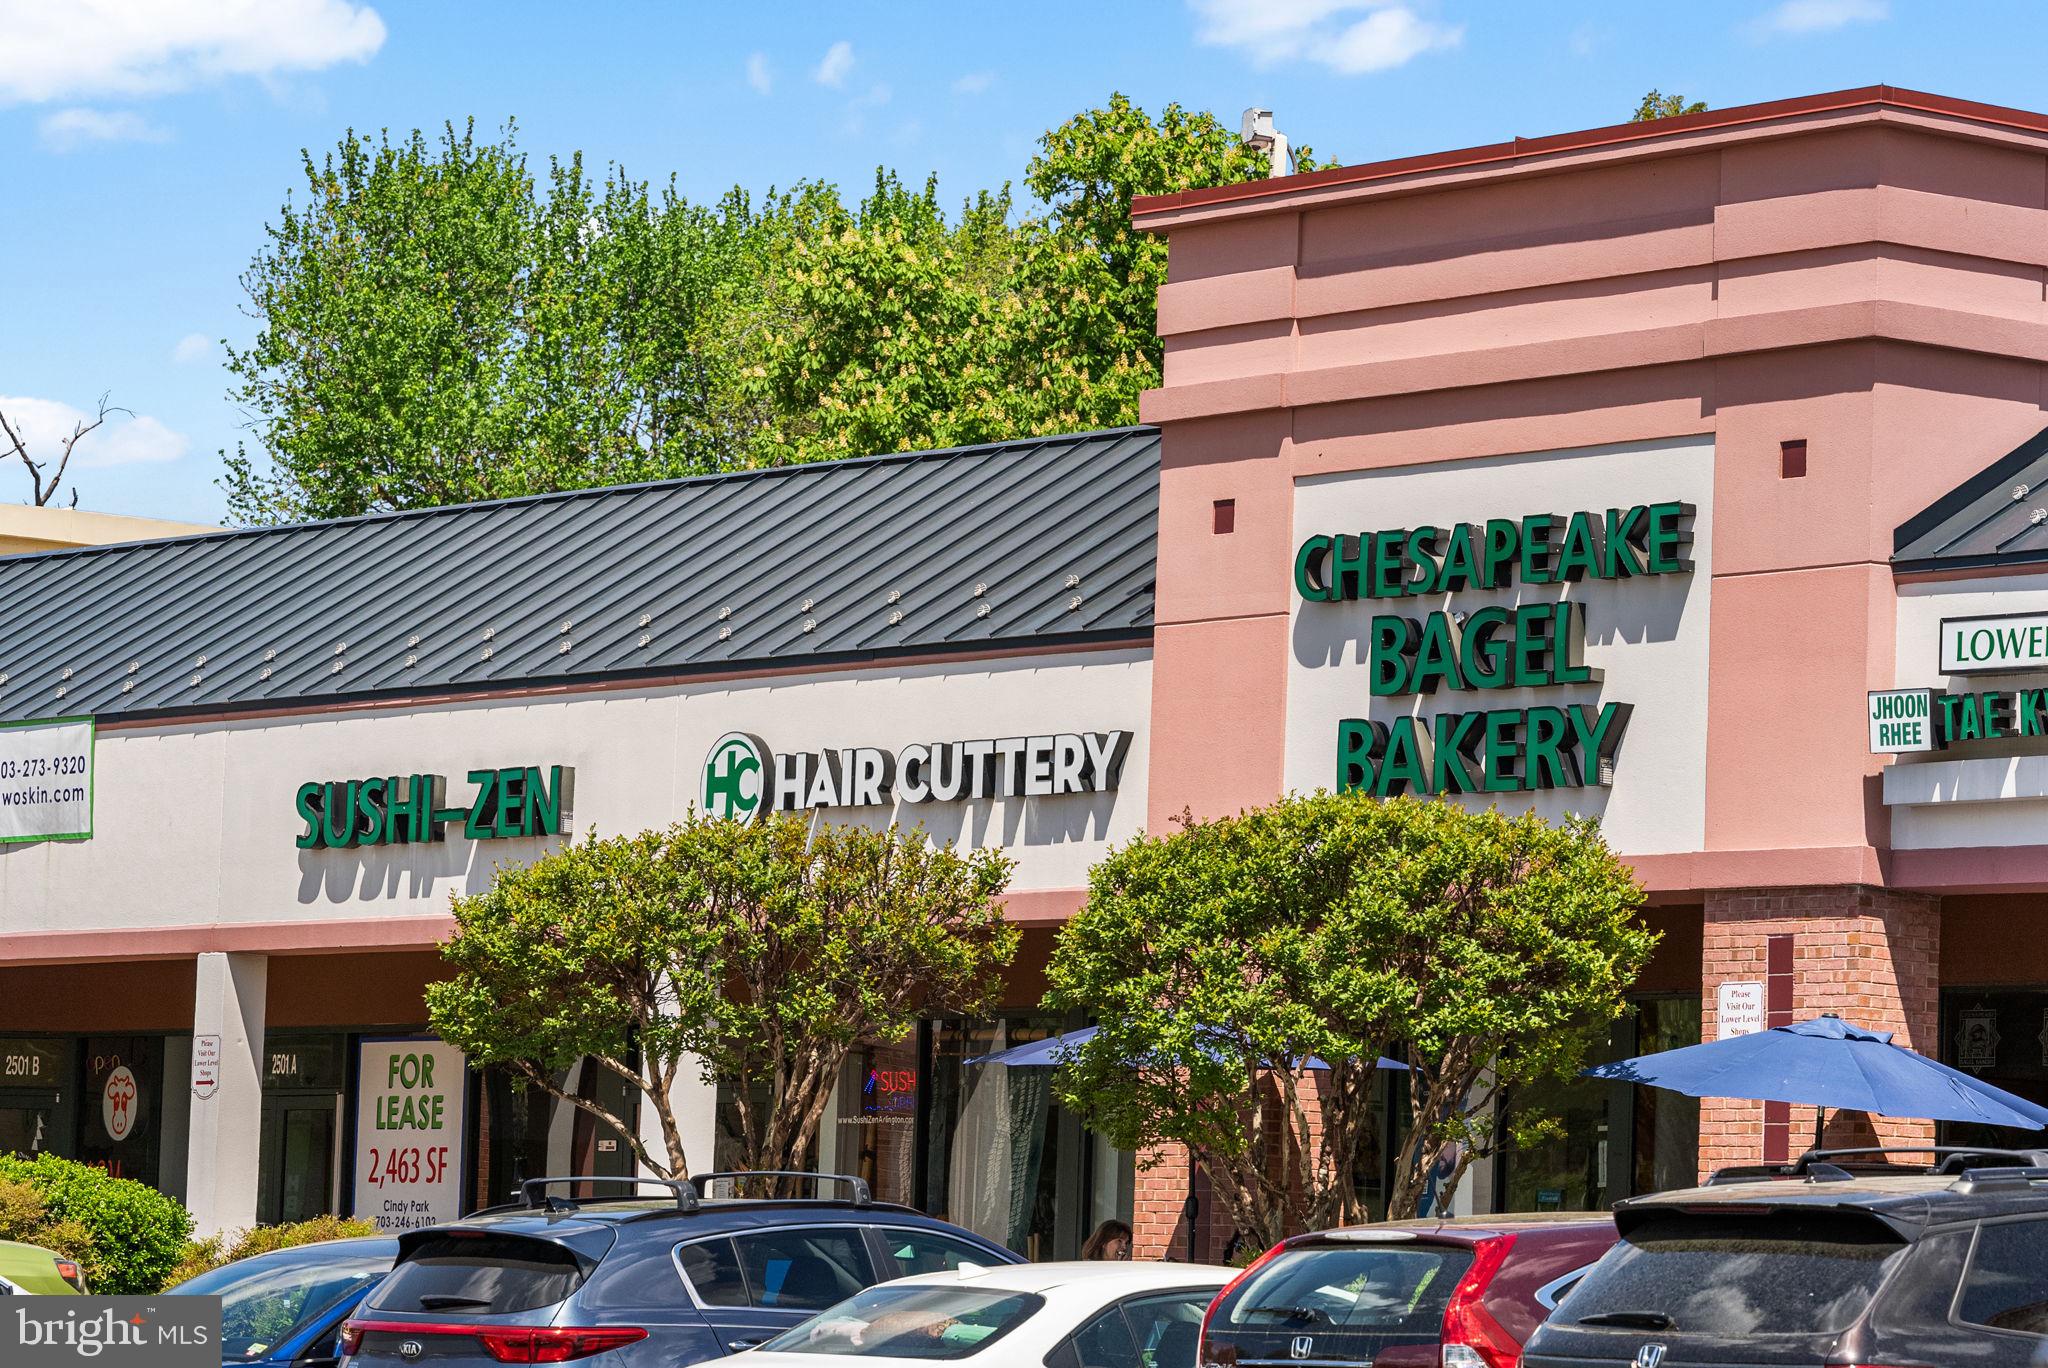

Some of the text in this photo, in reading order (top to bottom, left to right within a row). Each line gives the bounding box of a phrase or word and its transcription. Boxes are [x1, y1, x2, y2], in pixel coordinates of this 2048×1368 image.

[1294, 501, 1696, 603] CHESAPEAKE
[1370, 600, 1605, 696] BAGEL
[1956, 626, 2048, 662] LOWE
[1873, 694, 1928, 720] JHOON
[1938, 691, 2002, 742] TAE
[1336, 701, 1634, 800] BAKERY
[1879, 722, 1922, 747] RHEE
[775, 748, 895, 811] HAIR
[897, 731, 1134, 803] CUTTERY
[1731, 990, 1751, 998] Please
[1722, 1015, 1760, 1023] Lower Level
[5, 1055, 40, 1075] 2501 B
[272, 1054, 297, 1074] 2501 A
[388, 1053, 435, 1089] FOR
[376, 1095, 444, 1130] LEASE
[368, 1147, 448, 1189] 2,463 SF
[383, 1200, 429, 1214] Cindy Park
[403, 1344, 417, 1354] KIA
